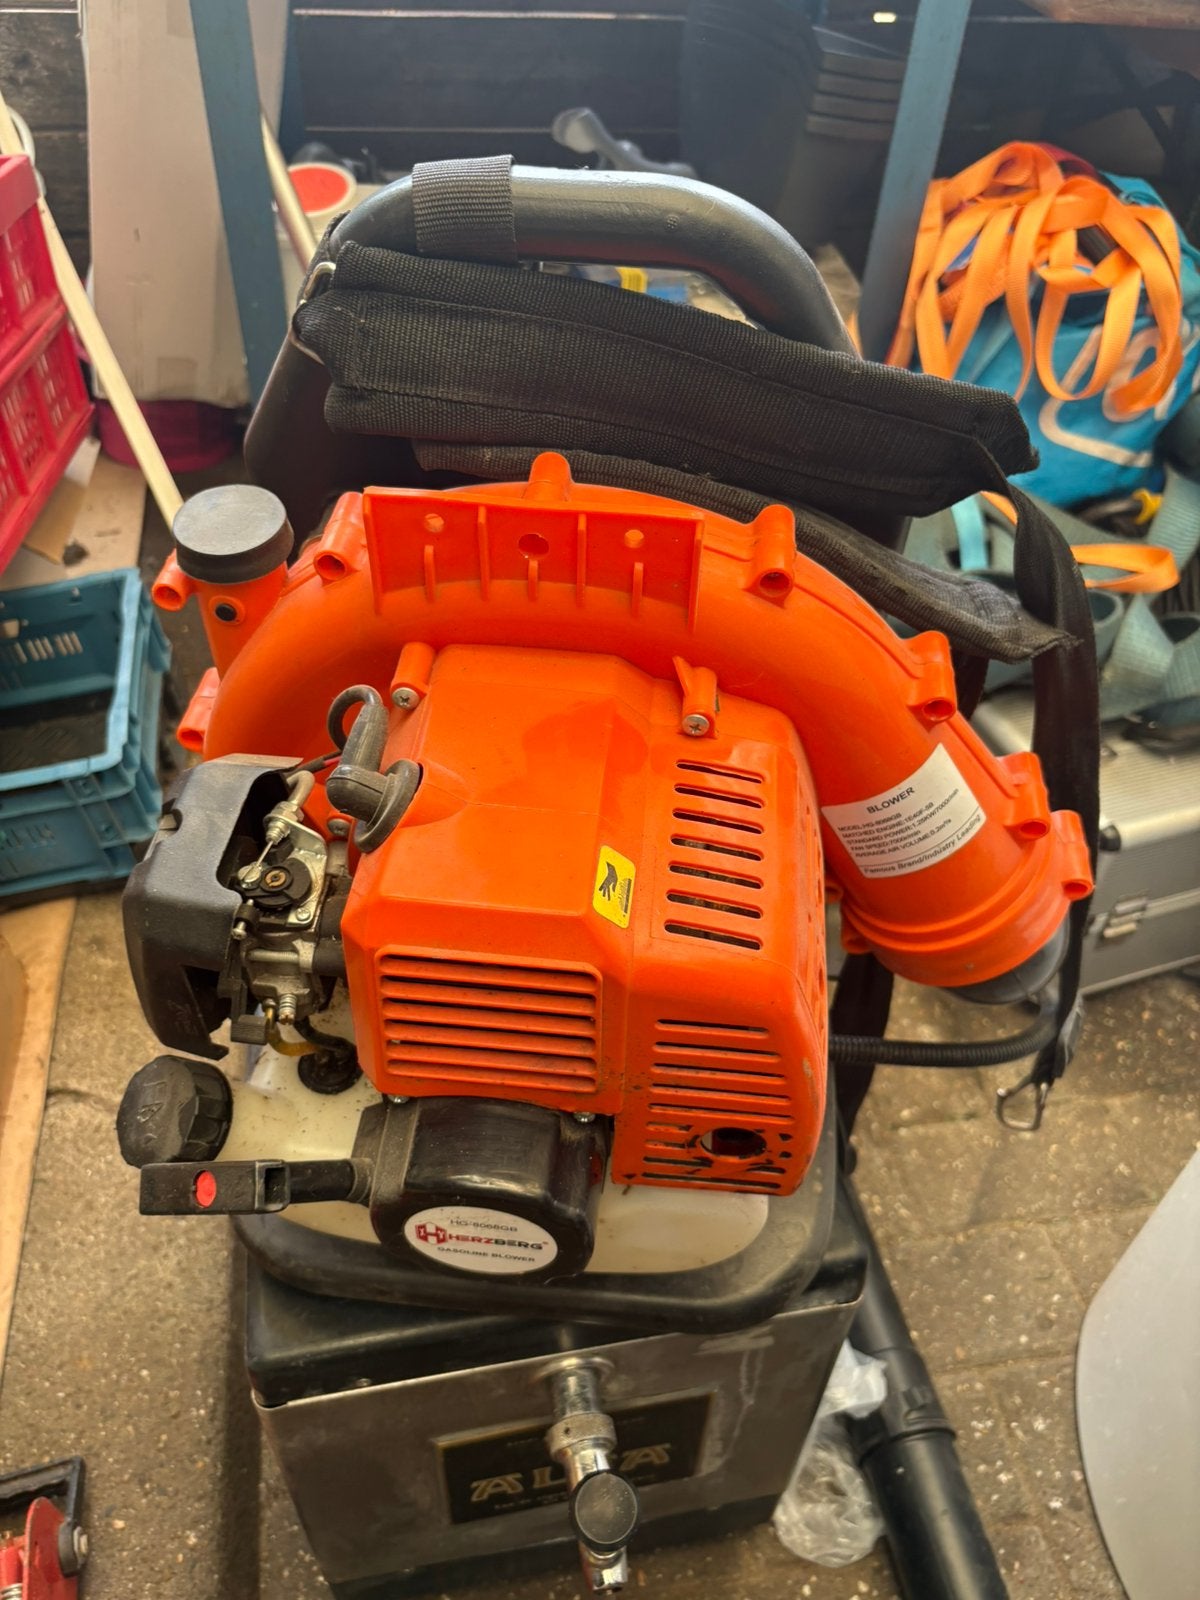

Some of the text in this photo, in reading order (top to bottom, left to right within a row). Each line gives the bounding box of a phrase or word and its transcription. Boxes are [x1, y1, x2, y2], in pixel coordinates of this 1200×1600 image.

[866, 787, 915, 814] BLOWER
[842, 829, 876, 839] MATCHED
[846, 834, 883, 845] STANDARD
[864, 815, 981, 875] Famous Brand/Industry Leading
[437, 1246, 535, 1262] GASOLINE BLOWER
[469, 1443, 671, 1502] ALA
